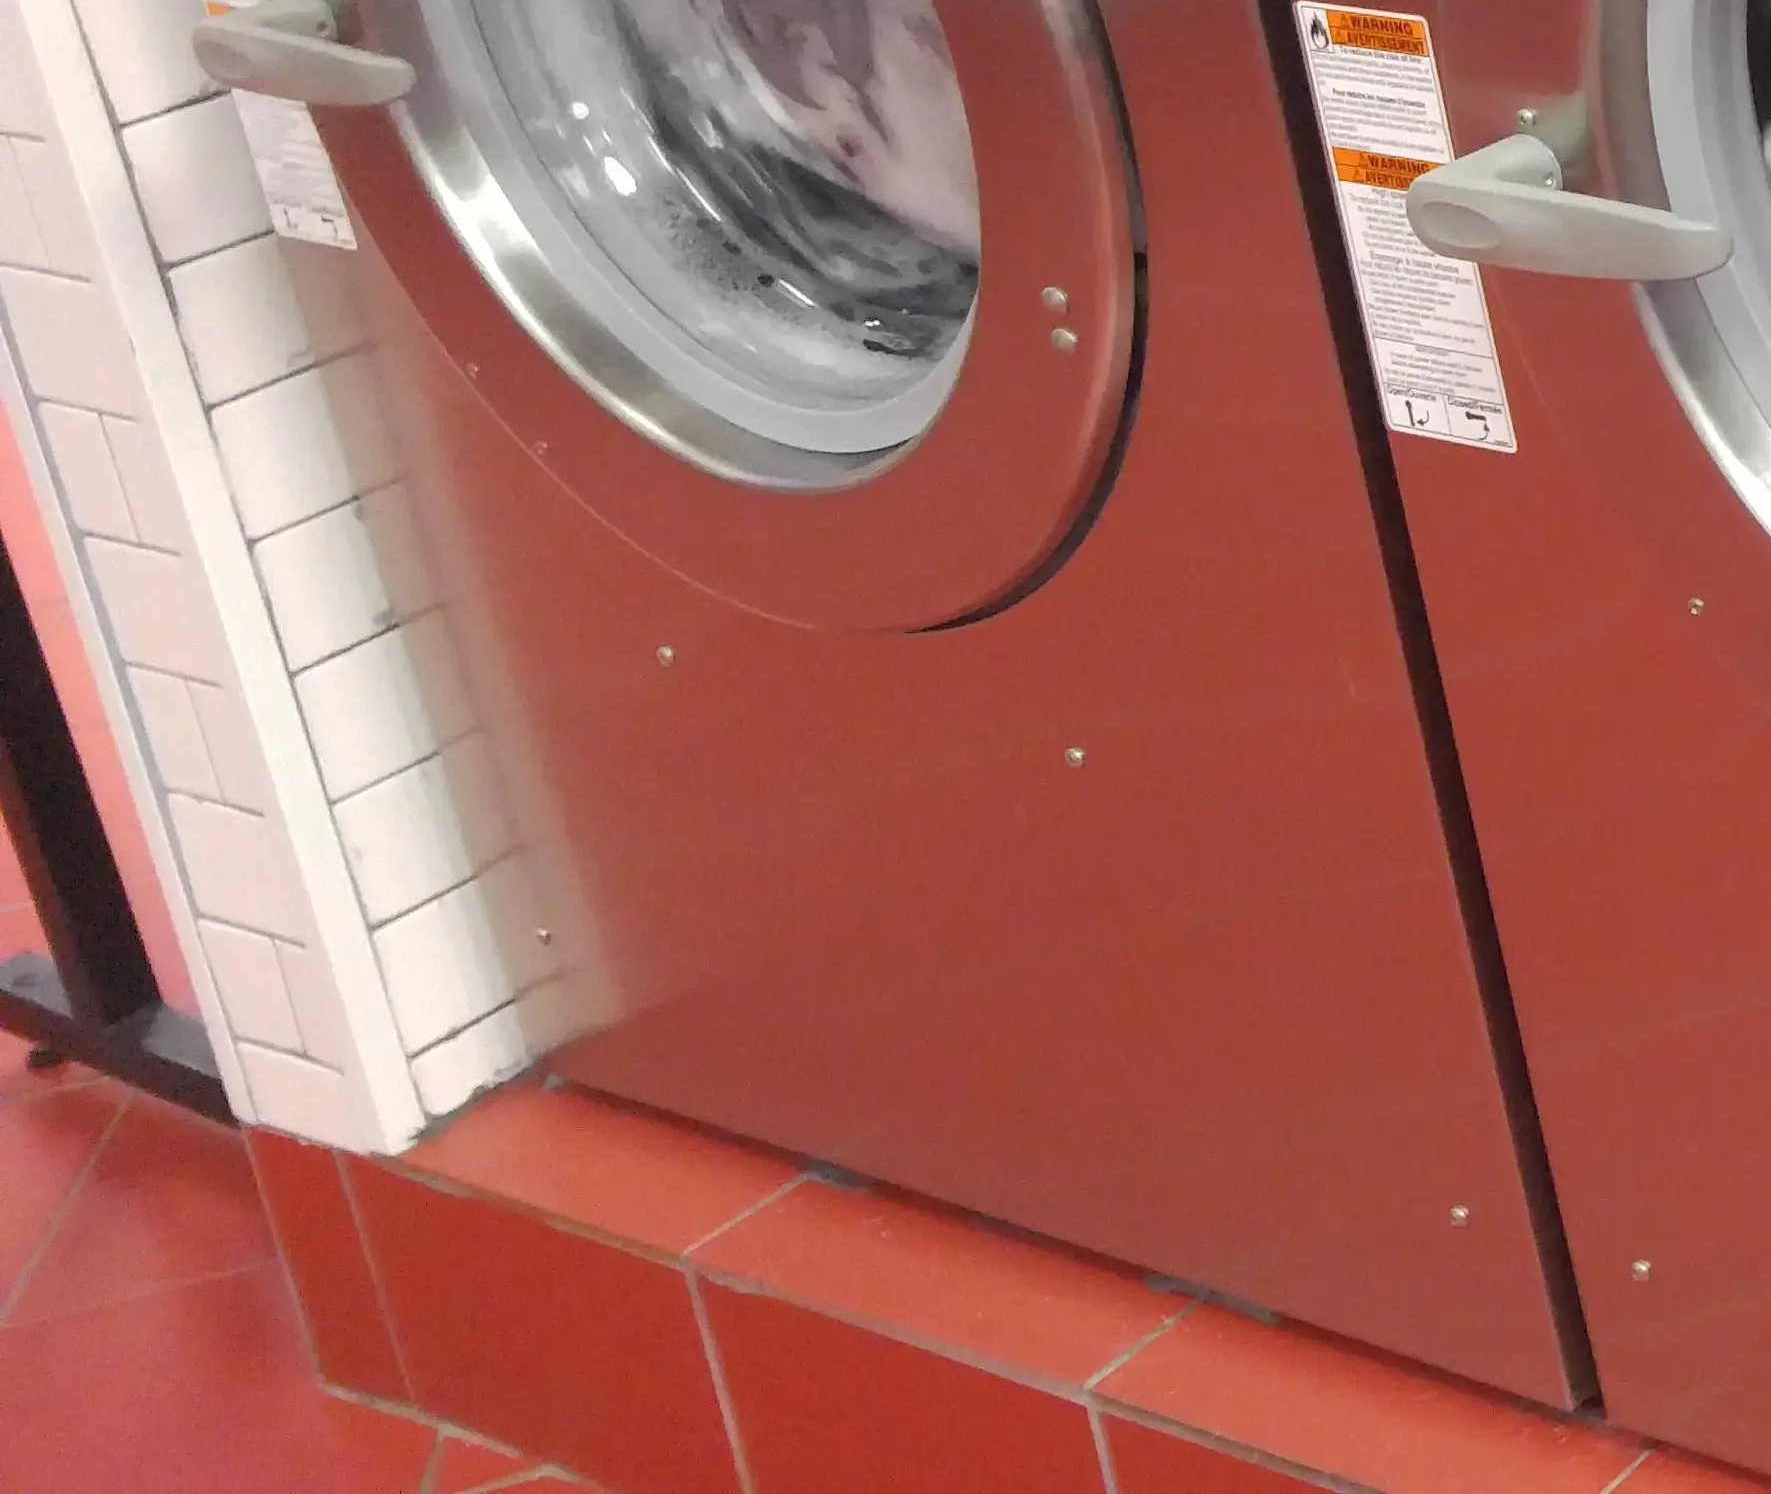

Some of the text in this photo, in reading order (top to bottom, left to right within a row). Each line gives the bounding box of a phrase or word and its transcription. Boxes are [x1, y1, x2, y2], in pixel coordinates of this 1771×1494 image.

[1350, 15, 1414, 36] WARNING
[1345, 31, 1425, 54] AVERTISSEMENT
[1366, 153, 1430, 175] WARNING
